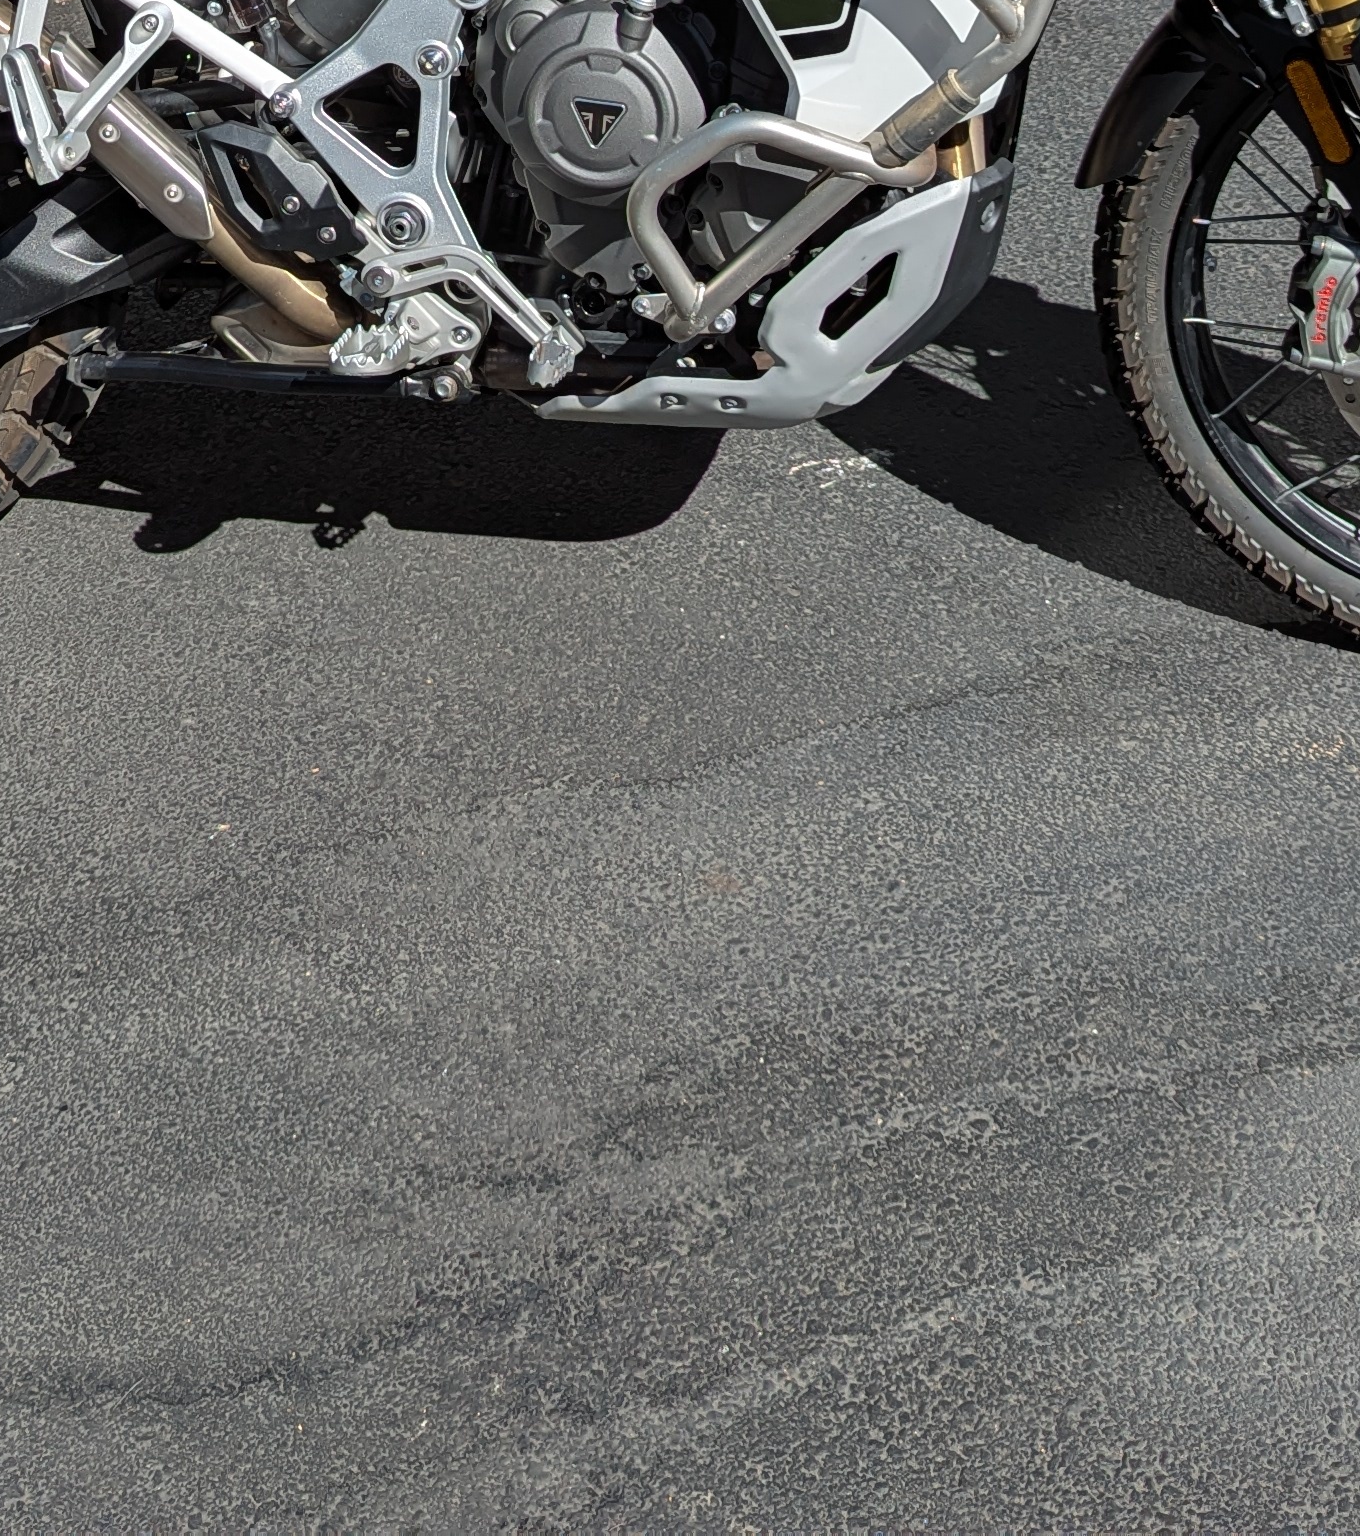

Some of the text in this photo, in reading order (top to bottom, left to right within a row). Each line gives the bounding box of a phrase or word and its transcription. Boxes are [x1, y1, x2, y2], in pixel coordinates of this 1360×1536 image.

[1146, 135, 1198, 325] TRAILMAX MISSION
[1310, 276, 1338, 345] brembo
